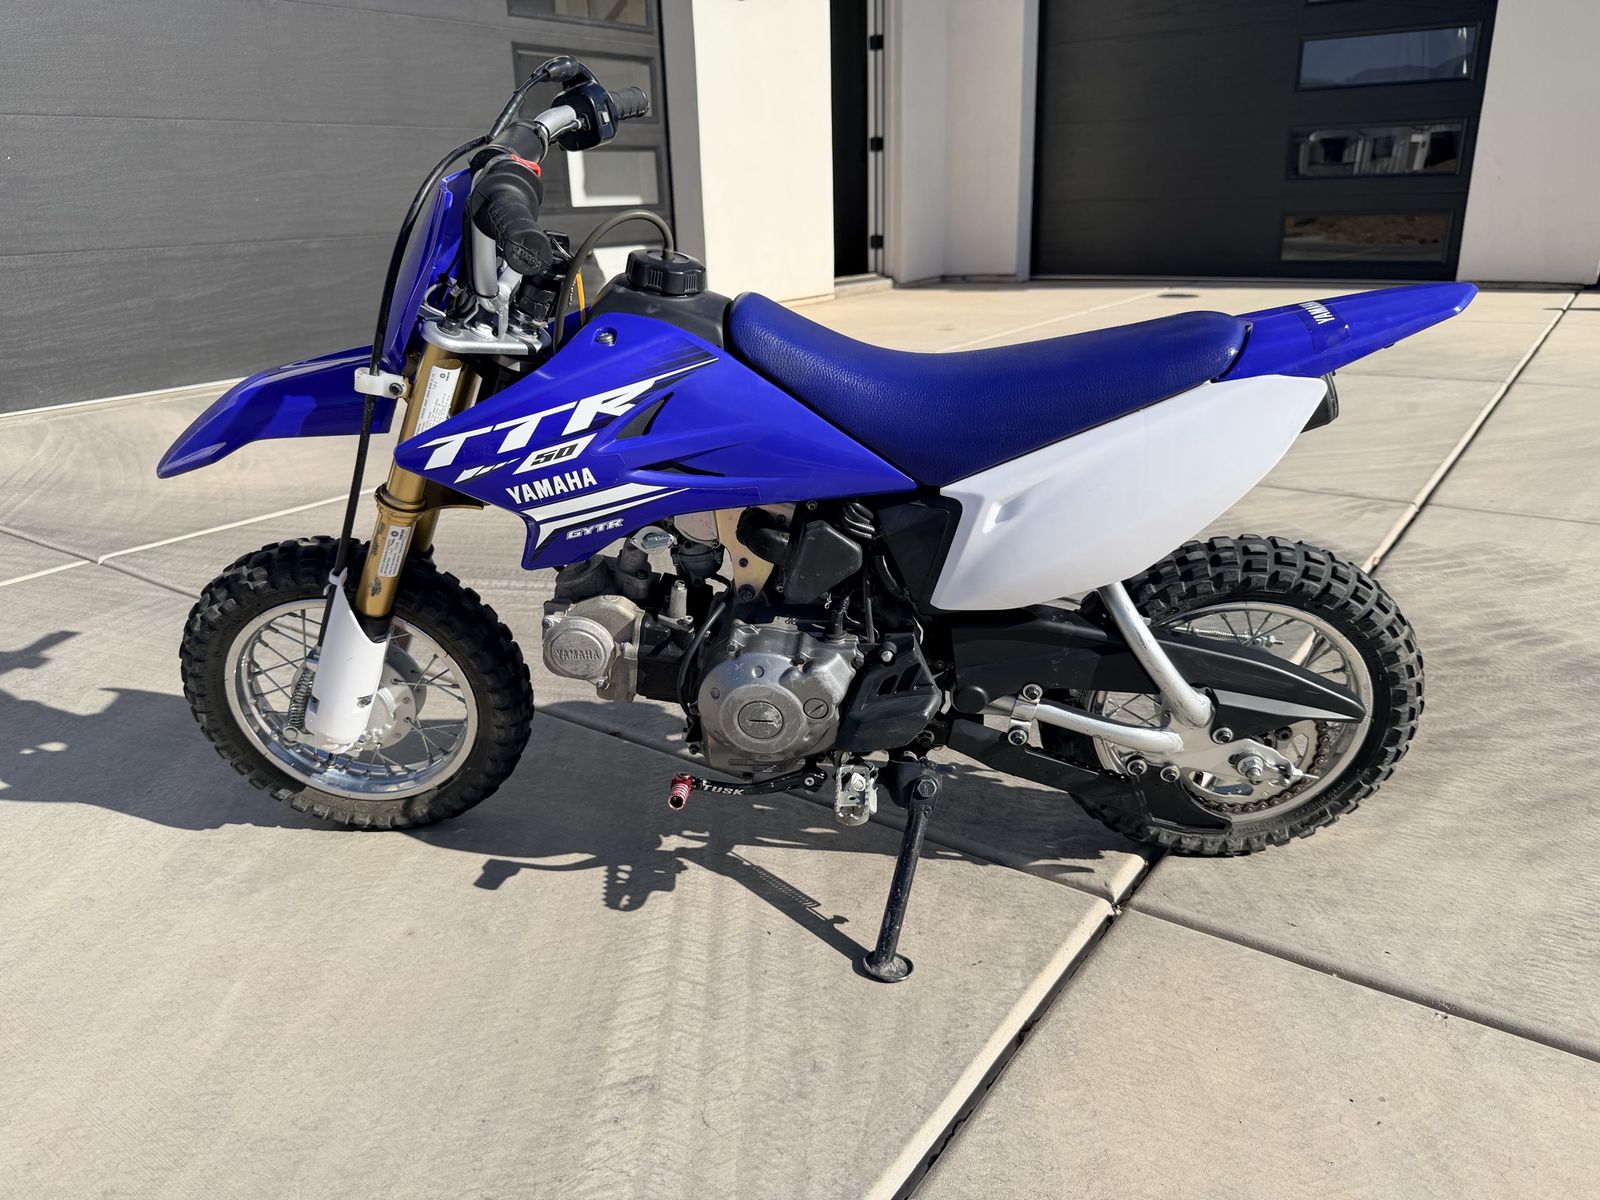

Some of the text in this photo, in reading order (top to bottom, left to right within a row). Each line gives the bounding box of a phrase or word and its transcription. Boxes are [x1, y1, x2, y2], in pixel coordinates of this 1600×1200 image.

[418, 380, 657, 471] TTR
[530, 443, 575, 467] 50
[505, 467, 598, 505] YAMAHA
[566, 518, 625, 540] GYTR
[553, 648, 600, 660] YAMAHA
[703, 784, 745, 796] TUSK
